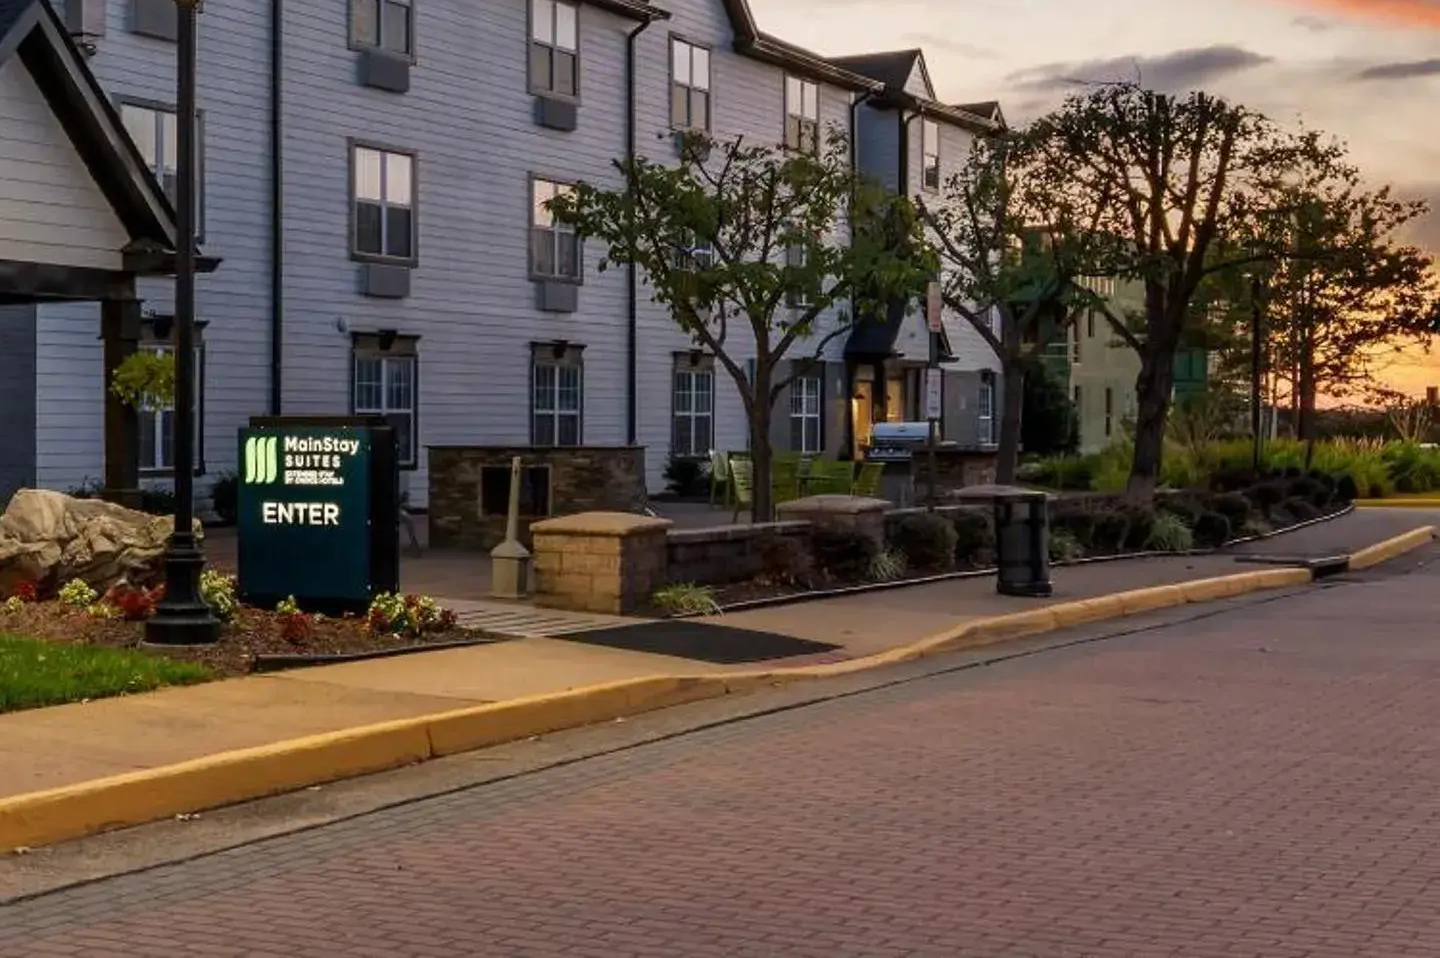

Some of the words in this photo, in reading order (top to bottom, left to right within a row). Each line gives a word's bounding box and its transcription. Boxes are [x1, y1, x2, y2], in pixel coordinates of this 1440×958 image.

[283, 436, 360, 456] MainStay
[284, 454, 341, 468] SUITES
[262, 502, 339, 525] ENTER
